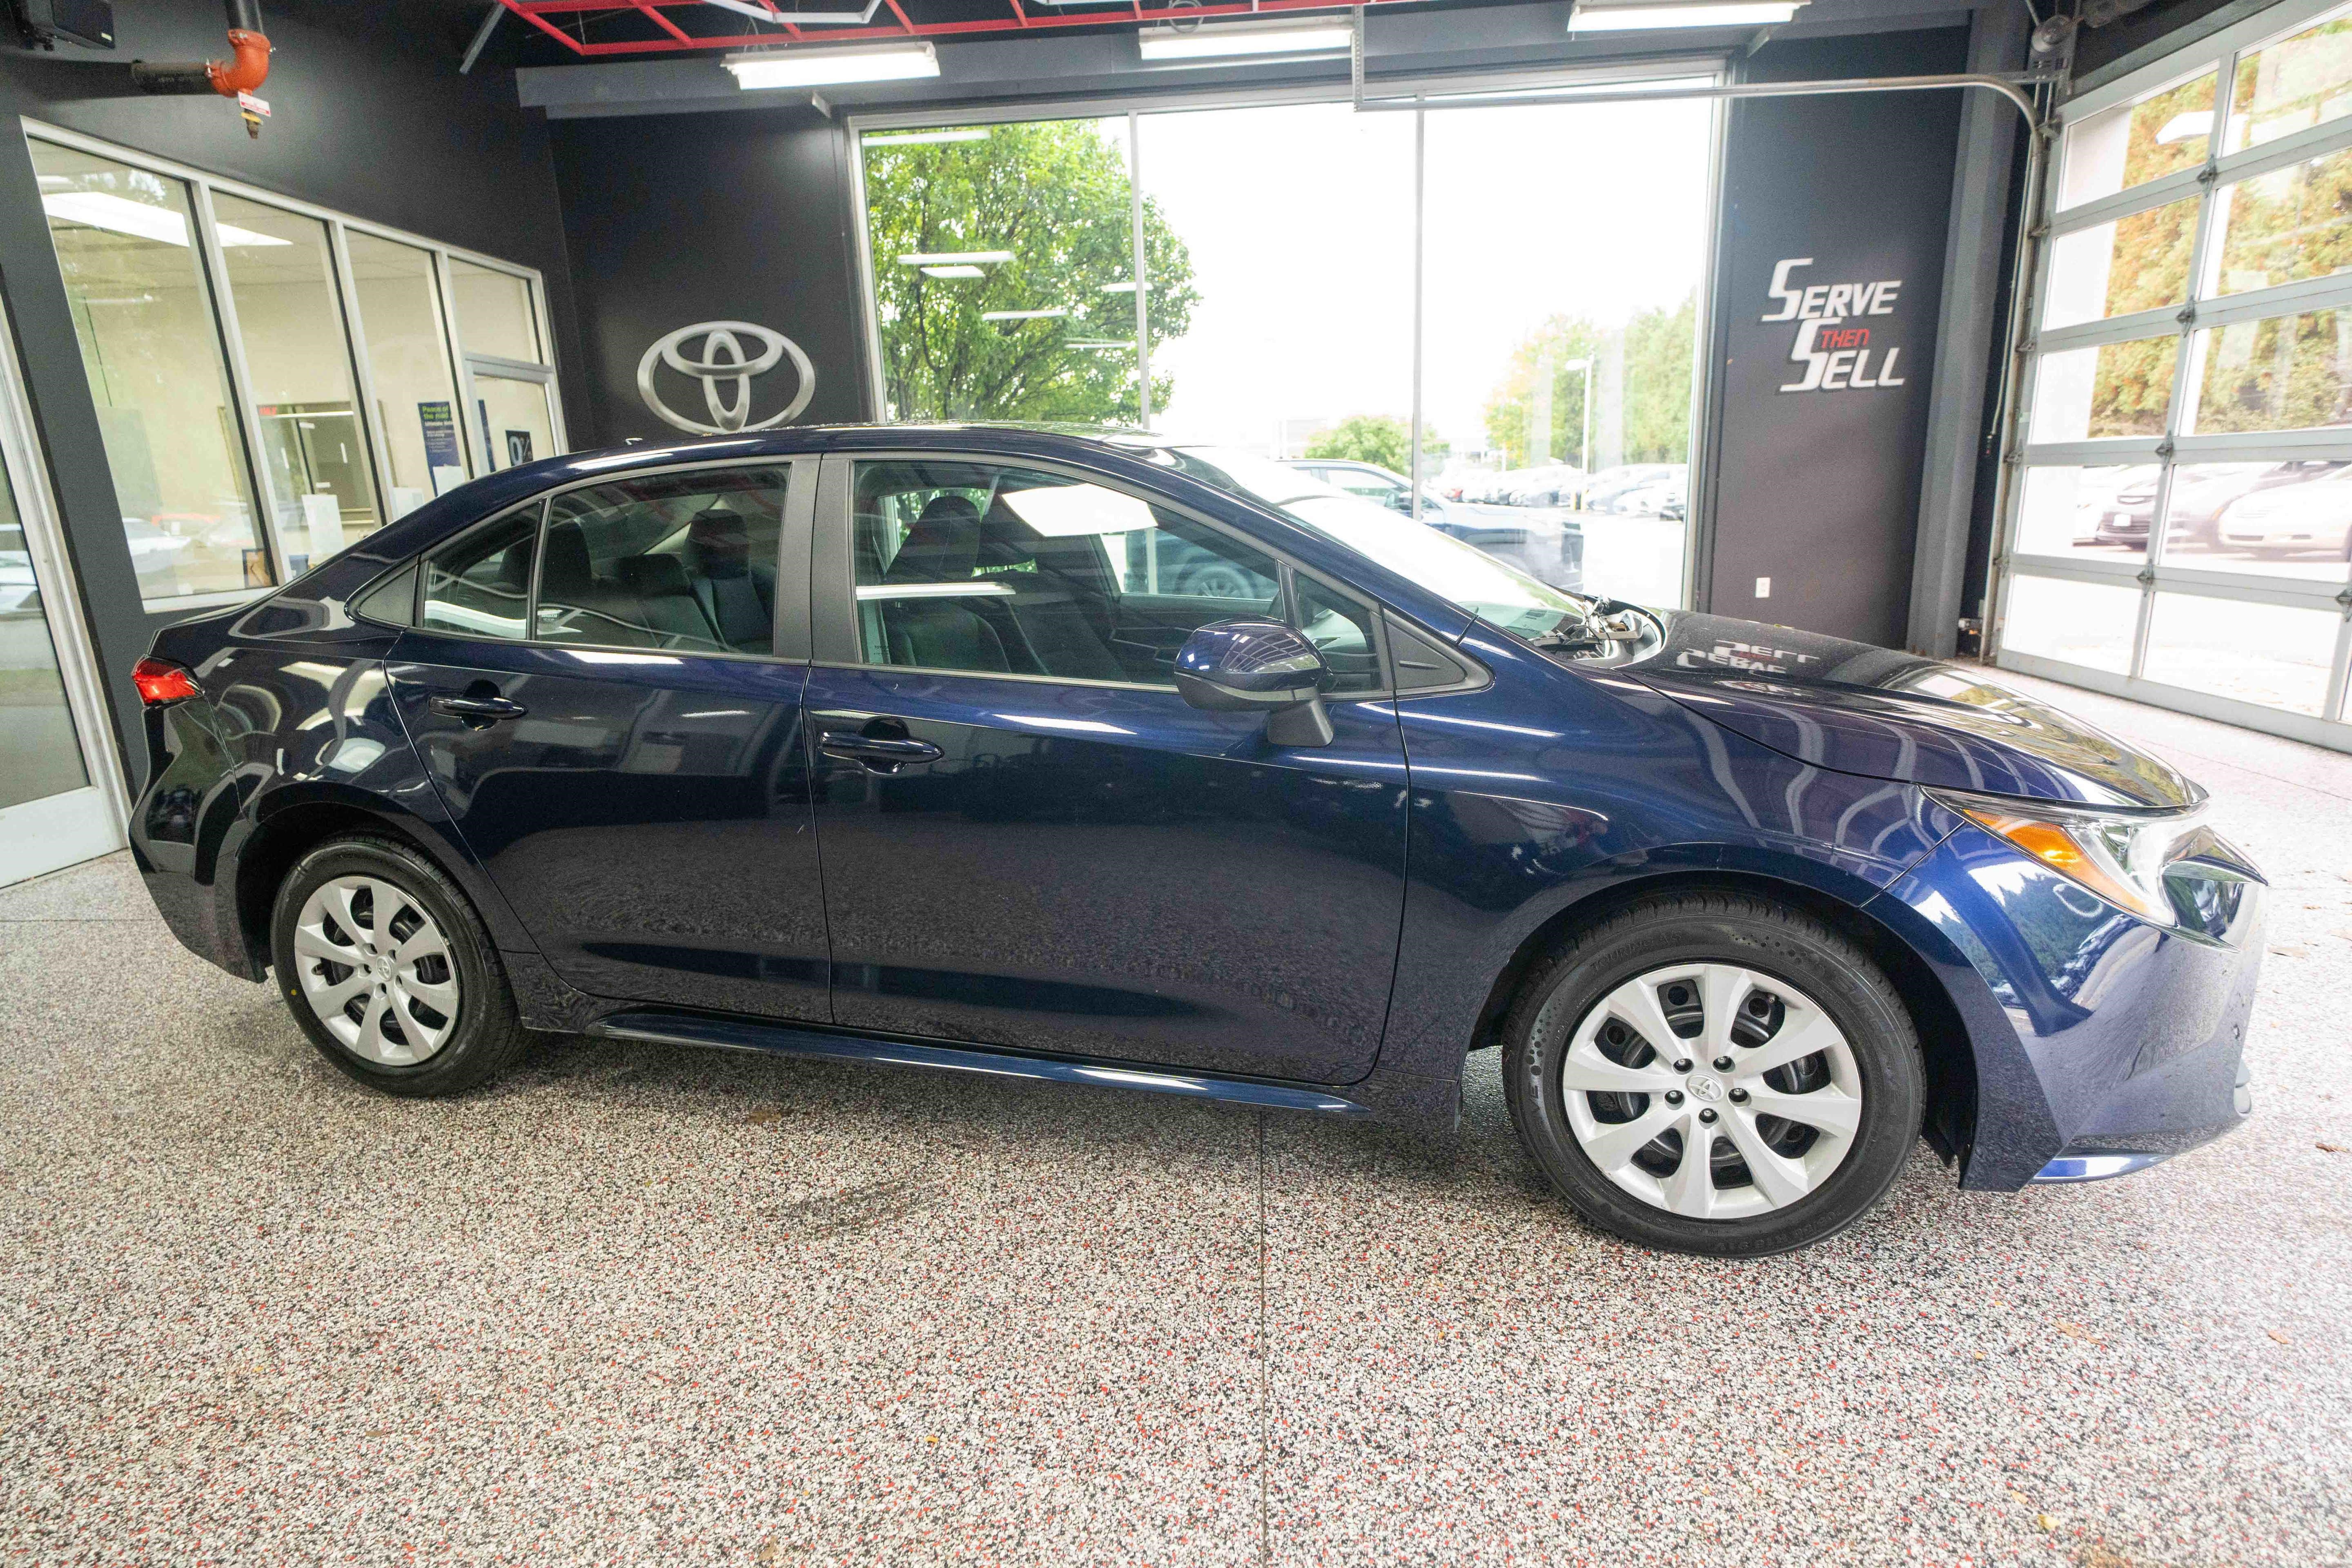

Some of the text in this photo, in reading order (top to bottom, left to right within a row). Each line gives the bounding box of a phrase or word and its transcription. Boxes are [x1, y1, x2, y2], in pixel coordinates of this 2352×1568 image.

[1762, 258, 1902, 322] SERVE
[1780, 317, 1905, 392] SELL
[1821, 328, 1869, 348] THEN
